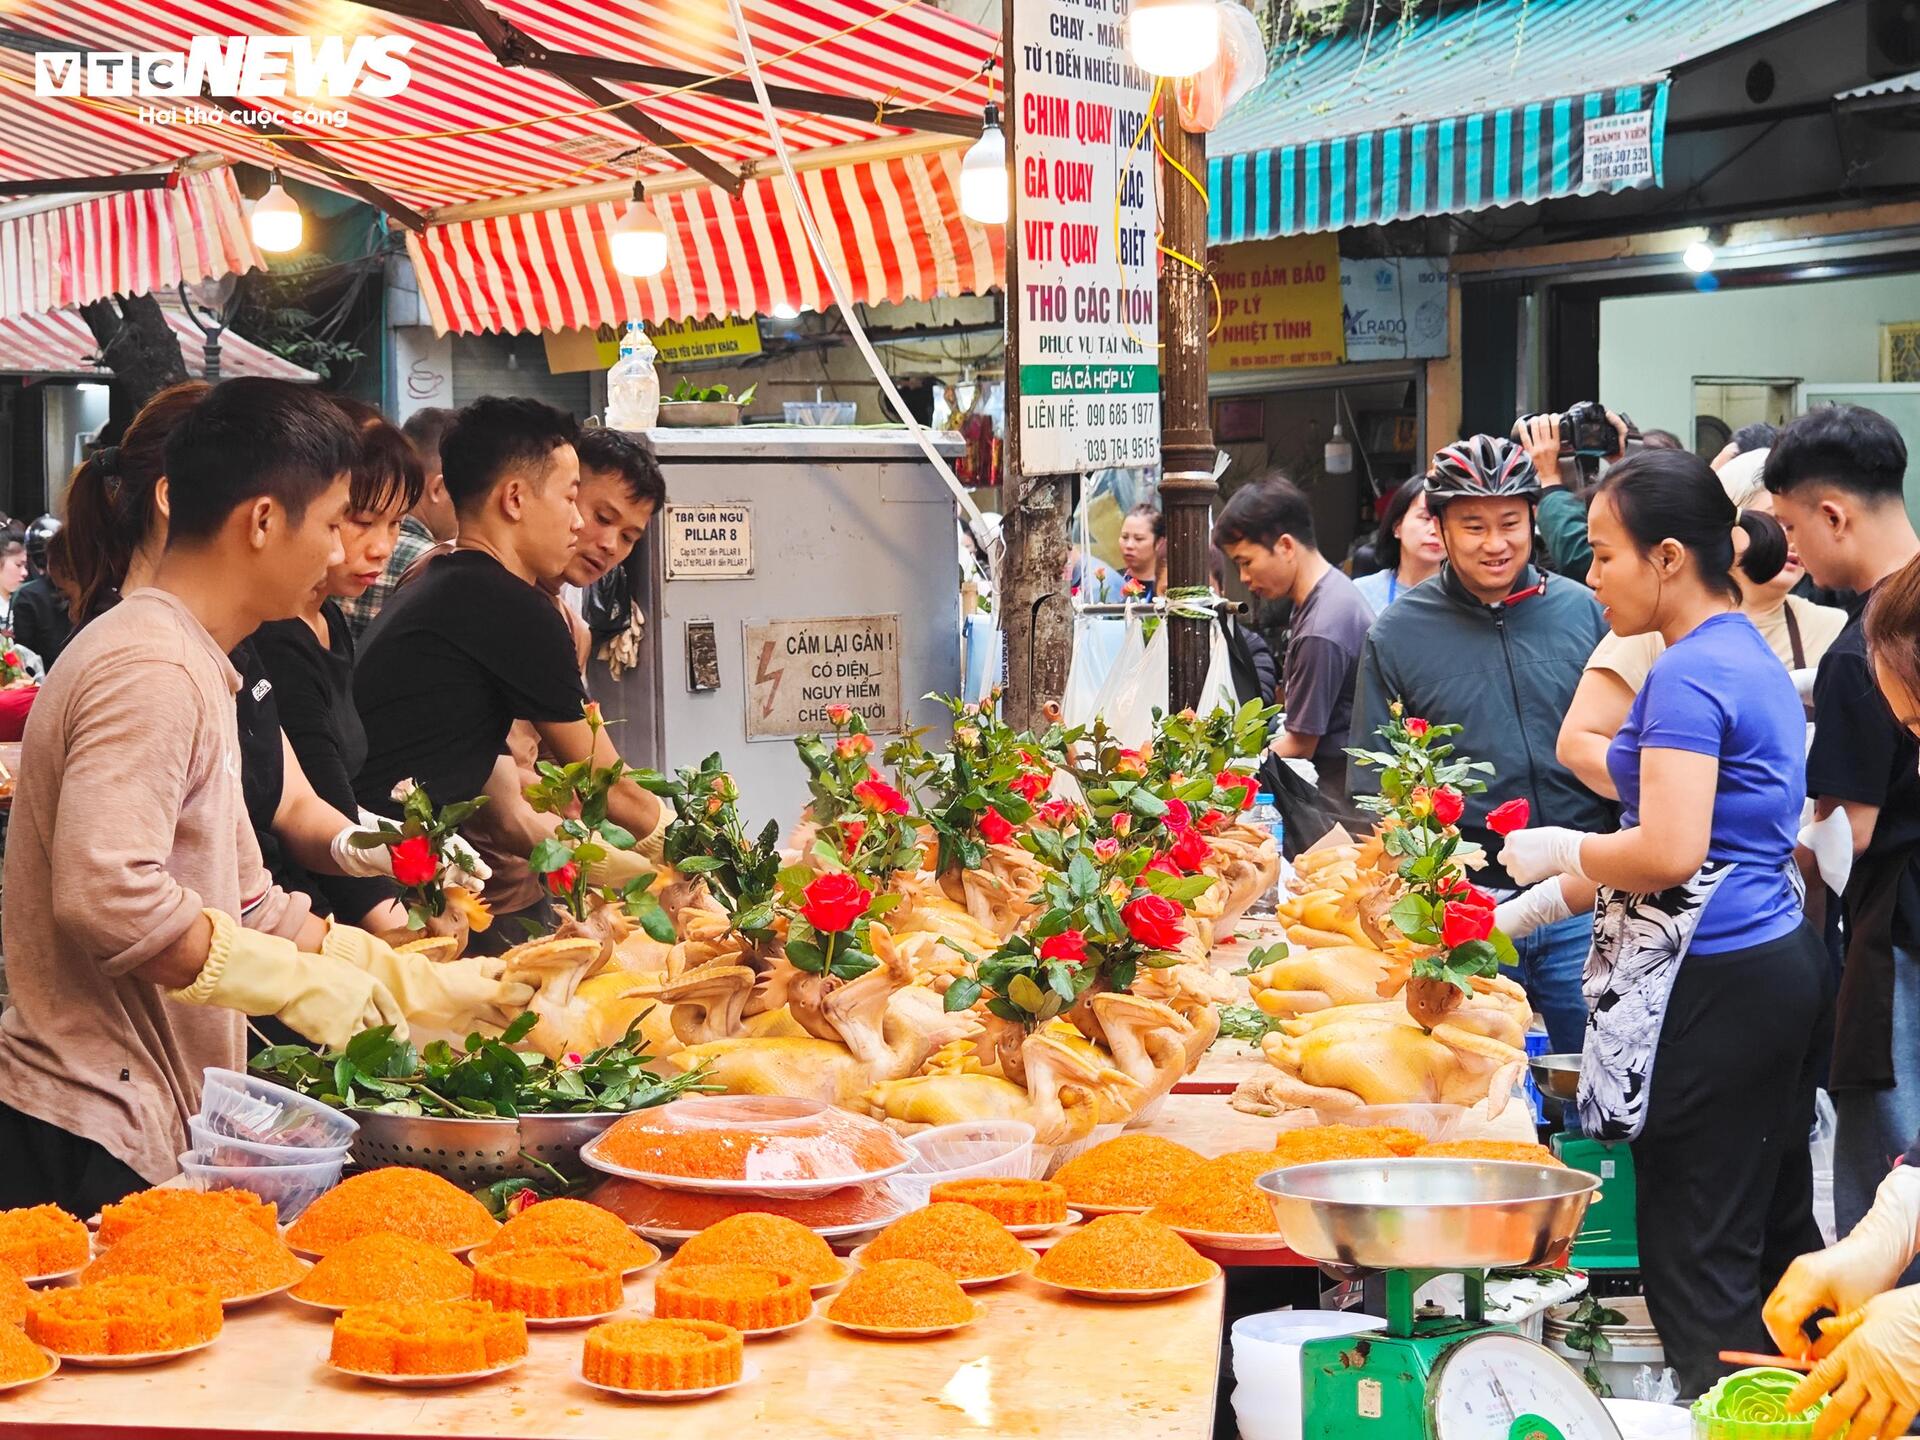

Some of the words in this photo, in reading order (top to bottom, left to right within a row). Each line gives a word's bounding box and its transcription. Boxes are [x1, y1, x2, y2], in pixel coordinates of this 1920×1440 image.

[1050, 13, 1084, 41] CHAY
[1098, 22, 1124, 52] MẶN
[1024, 42, 1041, 72] TỪ
[1046, 50, 1052, 74] 1
[1056, 48, 1081, 79] ĐẾN
[1024, 93, 1069, 139] CHIM
[1076, 101, 1113, 146] QUAY
[1025, 151, 1048, 198] GÀ
[1054, 160, 1094, 205] QUAY
[1025, 220, 1054, 270] VỊT
[1060, 222, 1098, 267] QUAY
[1120, 222, 1146, 274] BIỆT
[1026, 276, 1067, 322] THỎ
[1074, 281, 1110, 323] CÁC
[1117, 284, 1152, 325] MÓN
[1040, 335, 1073, 360] PHỤC
[1079, 336, 1093, 360] VỤ
[1098, 333, 1117, 360] TẠI
[1051, 365, 1073, 389] GIÁ
[1074, 365, 1092, 389] CẢ
[1094, 368, 1119, 394] HỢP
[1121, 365, 1135, 388] LÝ
[1028, 399, 1055, 429] LIÊN
[1060, 398, 1078, 432] HỆ:
[1087, 404, 1105, 426] 090
[1109, 403, 1127, 425] 685
[1132, 402, 1154, 424] 1977
[1087, 439, 1107, 462] 039
[1110, 438, 1128, 461] 764
[1132, 437, 1155, 460] 9515
[685, 528, 726, 541] PILLAR
[730, 528, 737, 541] 8
[787, 629, 820, 655] CẤM
[825, 634, 847, 657] LẠI
[852, 626, 883, 652] GẦN
[811, 661, 832, 678] CÓ
[837, 660, 868, 680] ĐIỆN
[802, 685, 842, 700] NGUY
[846, 677, 880, 698] HIỂM
[798, 704, 828, 722] CHẾ
[849, 702, 886, 719] GƯỜI
